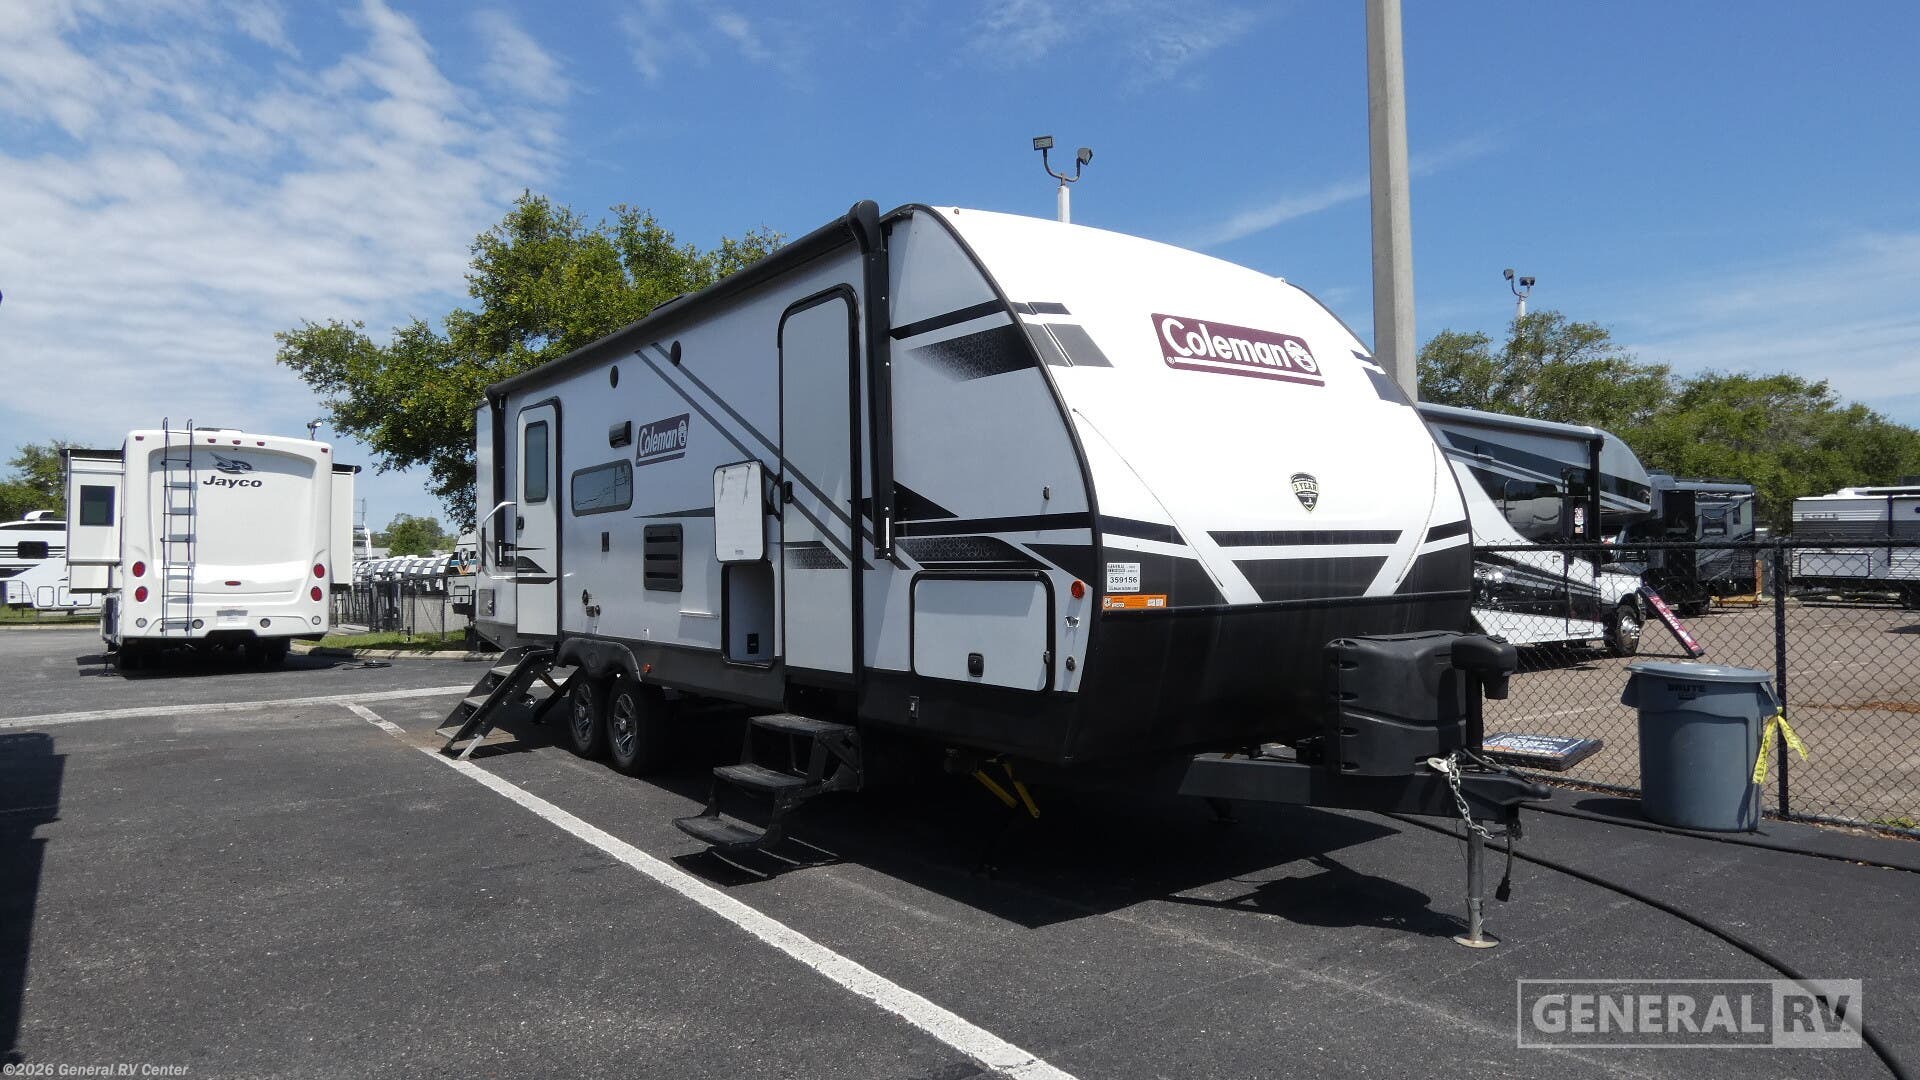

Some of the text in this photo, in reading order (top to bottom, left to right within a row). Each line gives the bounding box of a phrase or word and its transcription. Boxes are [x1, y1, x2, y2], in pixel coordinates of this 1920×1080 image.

[1162, 317, 1292, 368] Coleman
[639, 428, 677, 457] Coleman
[203, 475, 263, 488] Jayco
[1299, 482, 1317, 492] YEAR
[1109, 576, 1138, 584] 359156
[1667, 683, 1706, 693] BRUTE
